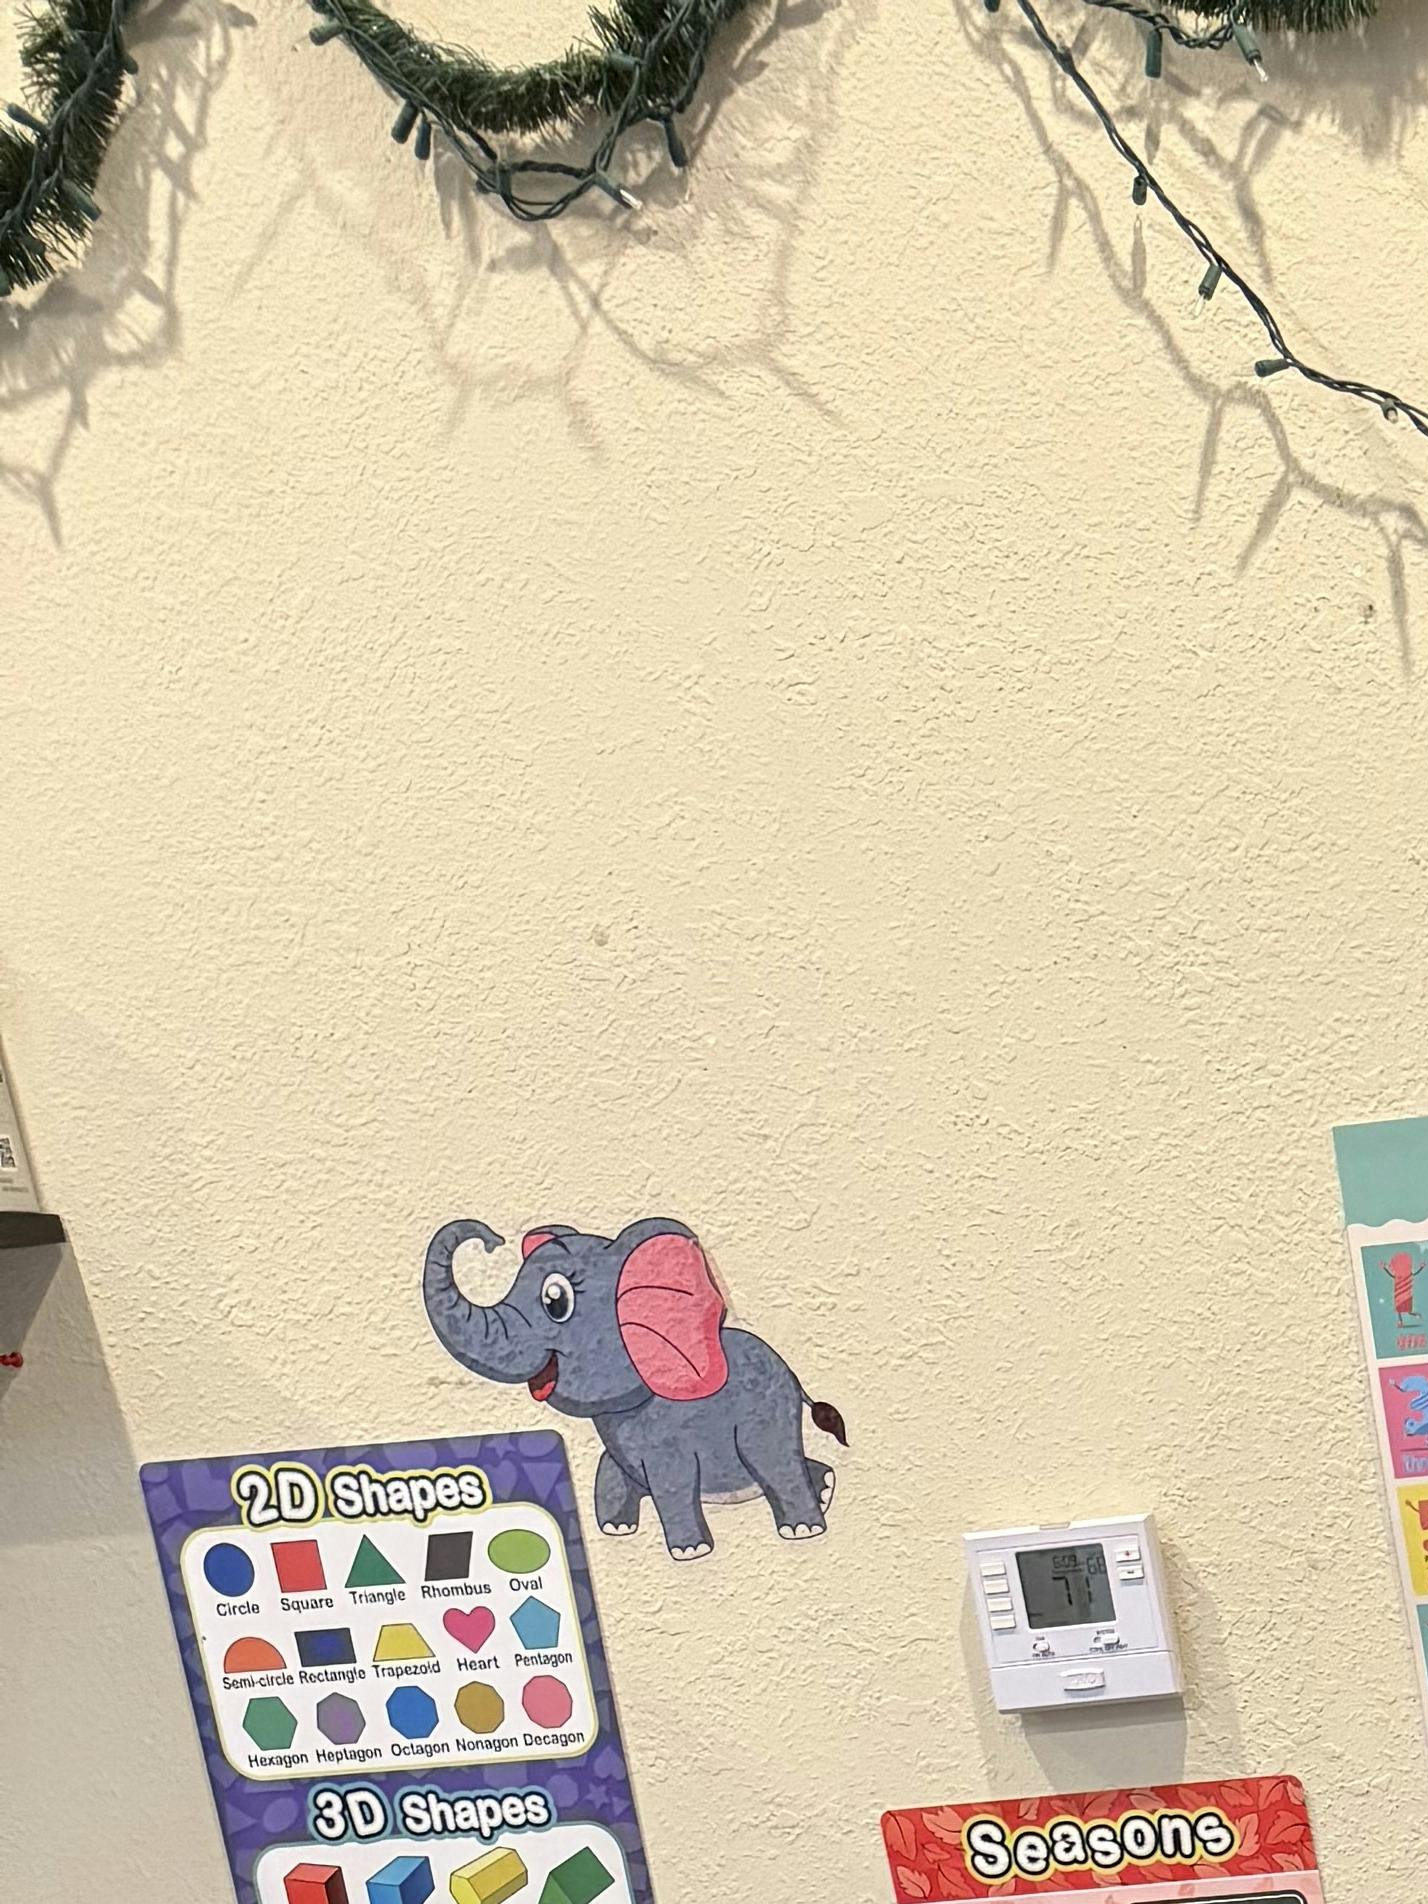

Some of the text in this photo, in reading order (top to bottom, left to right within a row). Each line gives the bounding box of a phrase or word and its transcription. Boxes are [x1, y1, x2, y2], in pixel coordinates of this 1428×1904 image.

[236, 1468, 490, 1526] 2D Shapes
[421, 1582, 491, 1599] Rhombus
[509, 1577, 543, 1592] Oval
[280, 1597, 334, 1612] Square
[349, 1589, 406, 1605] Triangle
[216, 1602, 260, 1616] Circle
[457, 1656, 500, 1672] Heart
[514, 1651, 573, 1668] Pentagon
[299, 1668, 366, 1685] Rectangle
[372, 1661, 440, 1679] Trapezoid
[223, 1673, 294, 1690] Semi-circle
[456, 1735, 518, 1752] Nonagon
[524, 1731, 585, 1748] Decagon
[316, 1746, 382, 1764] Heptagon
[391, 1741, 450, 1758] Octagon
[248, 1753, 308, 1768] Hexagon
[310, 1790, 551, 1840] 3D Shapes
[965, 1810, 1236, 1882] Seasons
